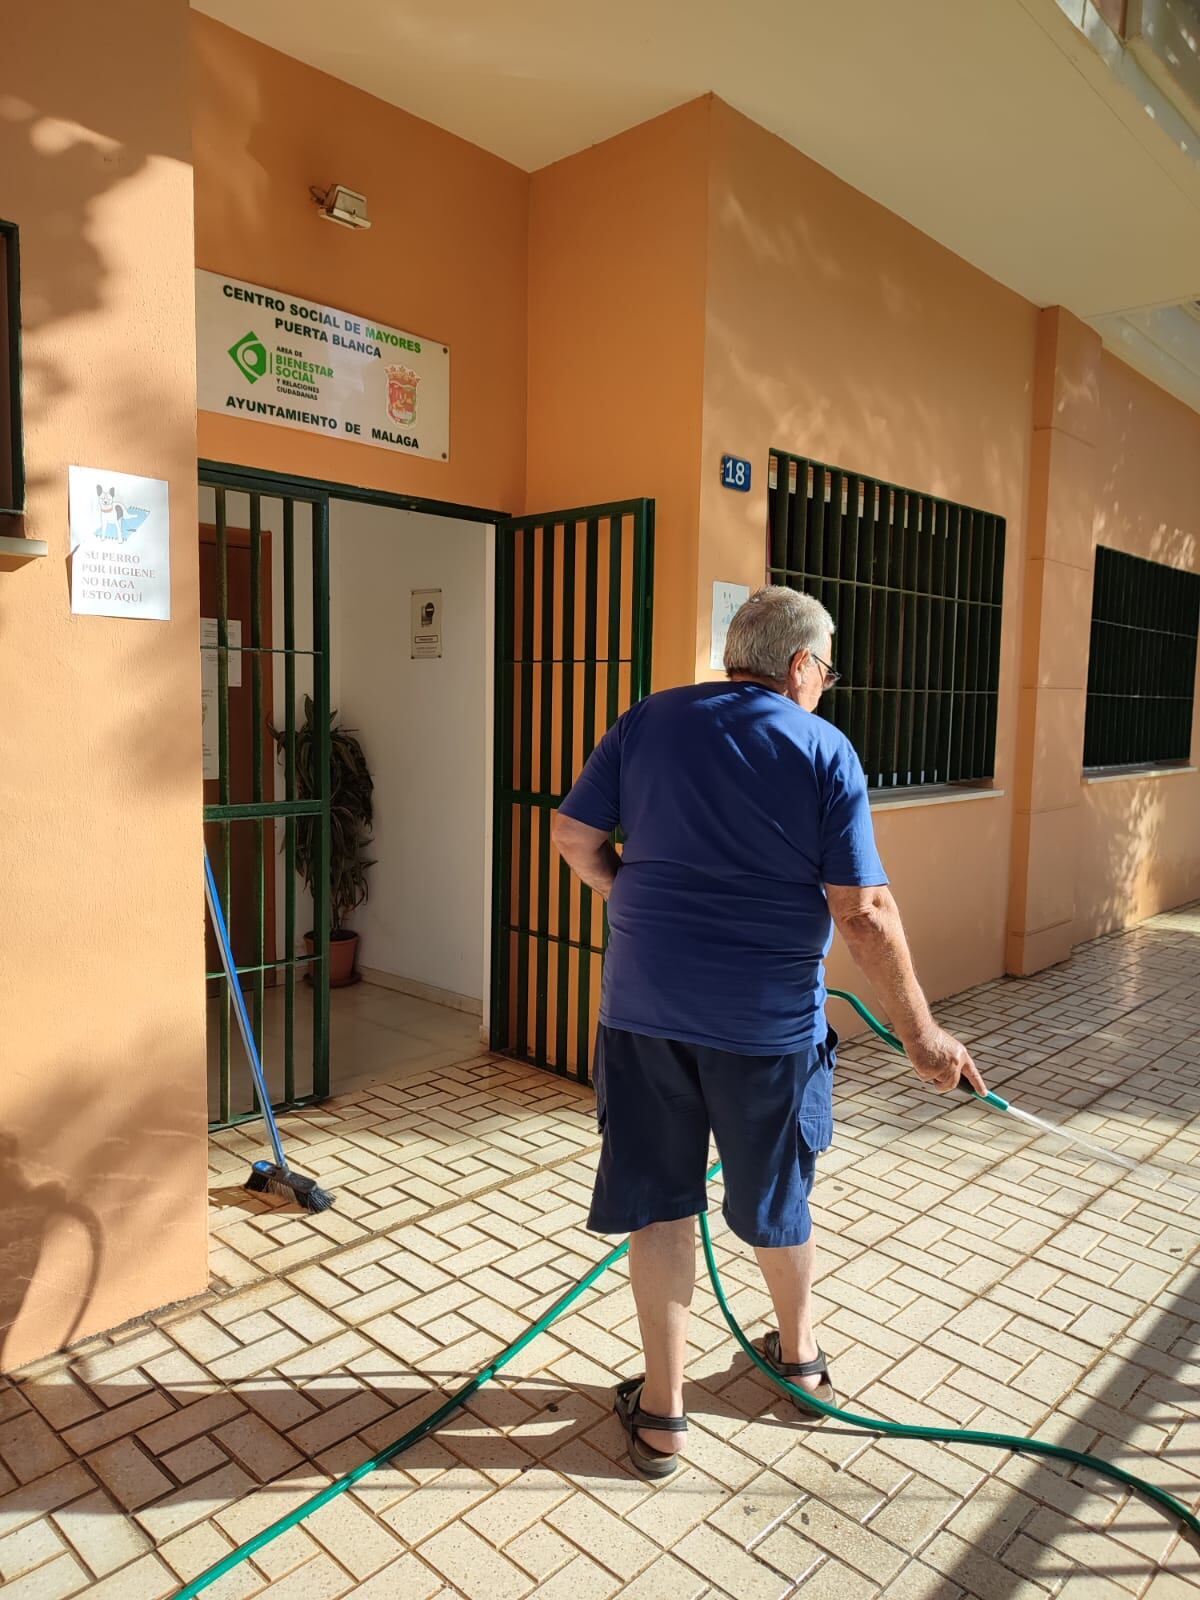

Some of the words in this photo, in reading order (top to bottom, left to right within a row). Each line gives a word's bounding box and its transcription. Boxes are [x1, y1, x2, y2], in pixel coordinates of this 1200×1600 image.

[223, 284, 285, 312] CENTRO
[290, 303, 340, 328] SOCIAL
[344, 320, 361, 335] DE
[365, 326, 422, 354] MAYORES
[275, 318, 328, 342] PUERTA
[332, 335, 382, 359] BLANCA
[295, 349, 303, 357] DE
[276, 355, 334, 378] BIENESTAR
[275, 365, 315, 385] SOCIAL
[276, 386, 318, 401] CIUDADANAS
[282, 380, 320, 394] RELACIONES
[225, 396, 337, 429] AYUNTAMIENTO
[345, 422, 361, 435] DE
[371, 428, 419, 449] MALAGA
[725, 459, 745, 485] 18
[85, 551, 99, 560] SU
[102, 553, 140, 564] PERRO
[82, 564, 105, 573] POR
[109, 567, 156, 578] HIGIENE
[82, 576, 99, 585] NO
[102, 578, 135, 589] HAGA
[82, 590, 112, 600] ESTO
[114, 591, 142, 603] AQUÍ
